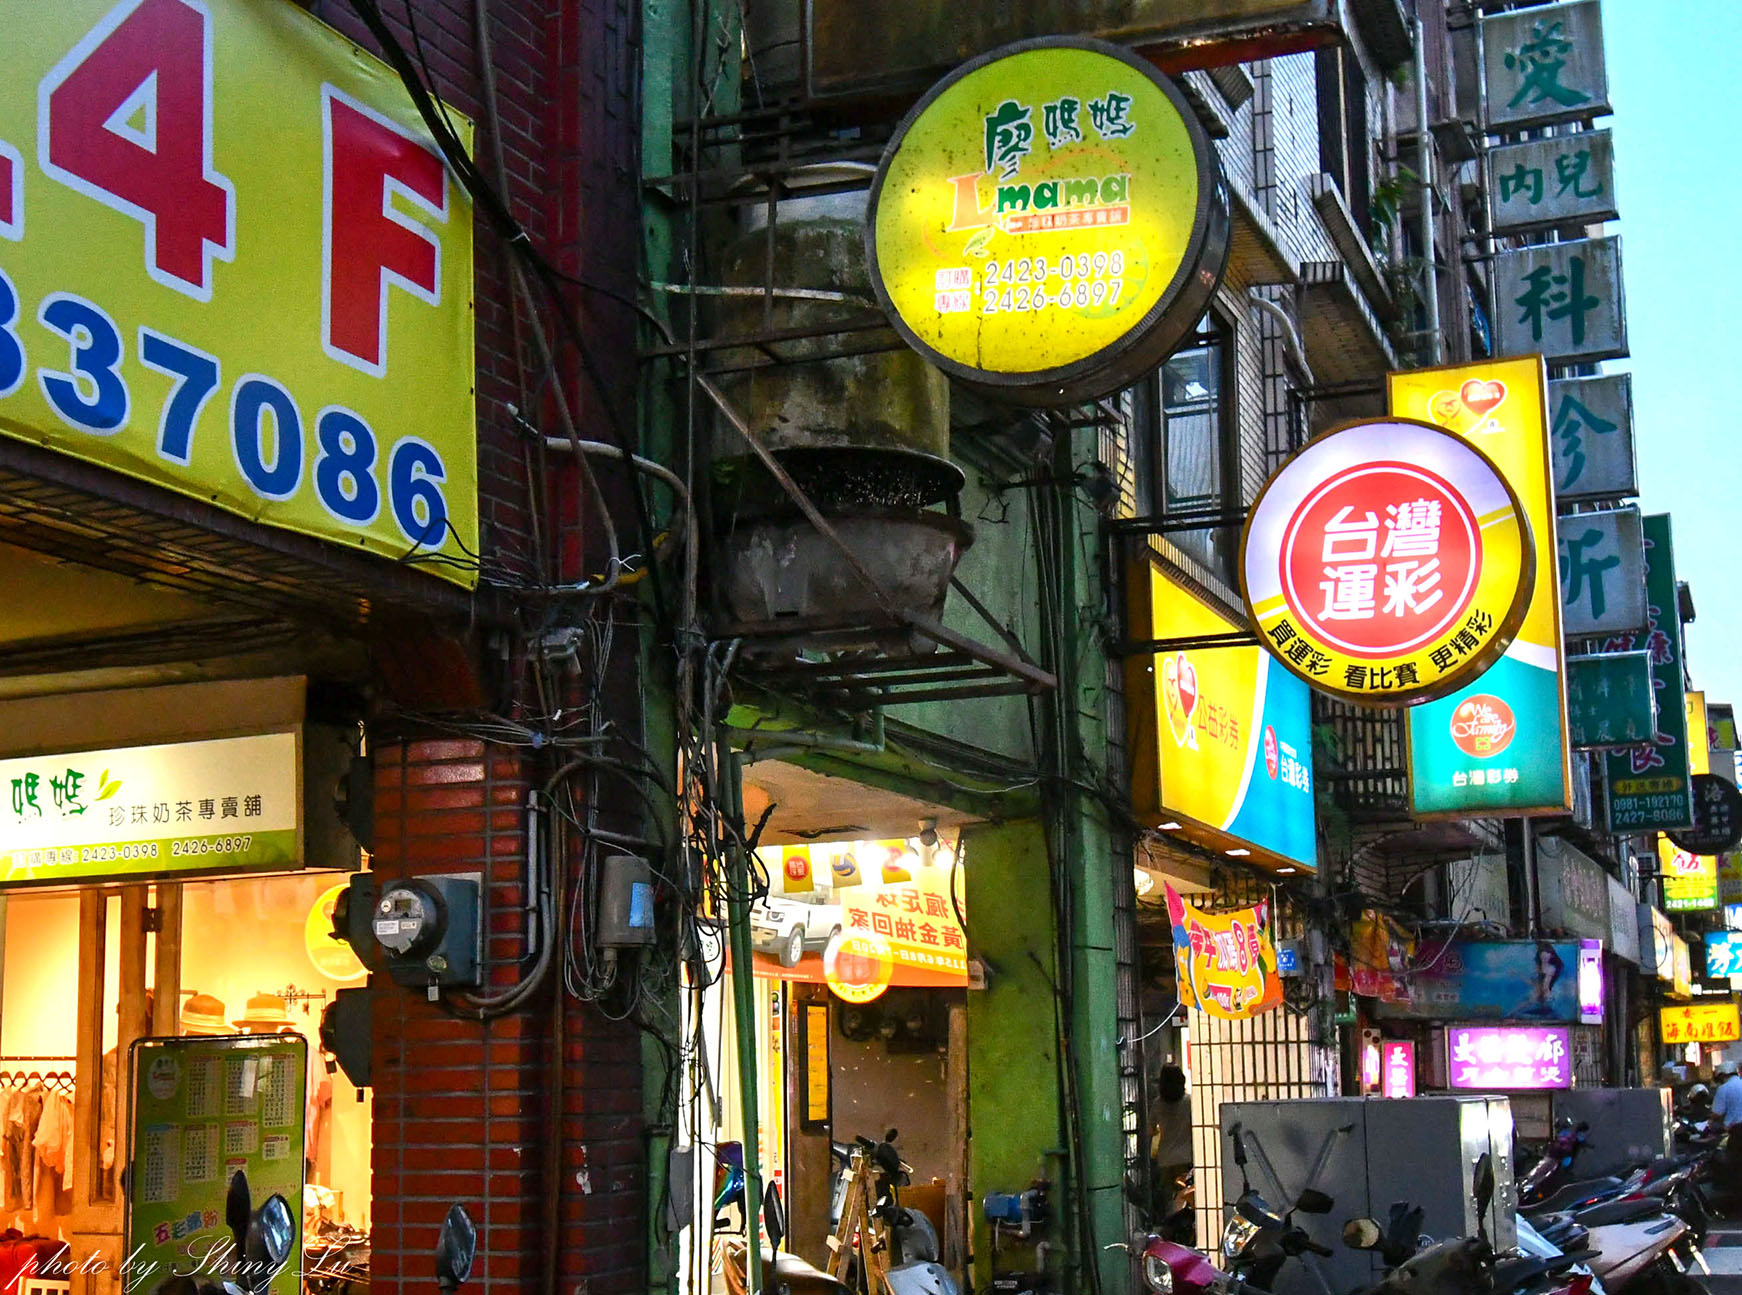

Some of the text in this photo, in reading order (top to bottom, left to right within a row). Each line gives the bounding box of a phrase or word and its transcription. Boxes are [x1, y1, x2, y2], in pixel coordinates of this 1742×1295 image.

[1503, 20, 1592, 109] 愛
[984, 280, 1123, 313] 2426-6897
[986, 251, 1124, 285] 2423-0398
[1515, 256, 1601, 346] 科
[0, 270, 448, 552] 37086
[1320, 498, 1442, 564] 台灣
[1317, 556, 1444, 622] 運彩
[1267, 608, 1493, 690] 買運彩 看比賽 更精彩
[108, 795, 262, 827] 珍珠奶茶專賣舖
[82, 844, 158, 862] 2423-0398
[172, 837, 252, 857] 2426-6897
